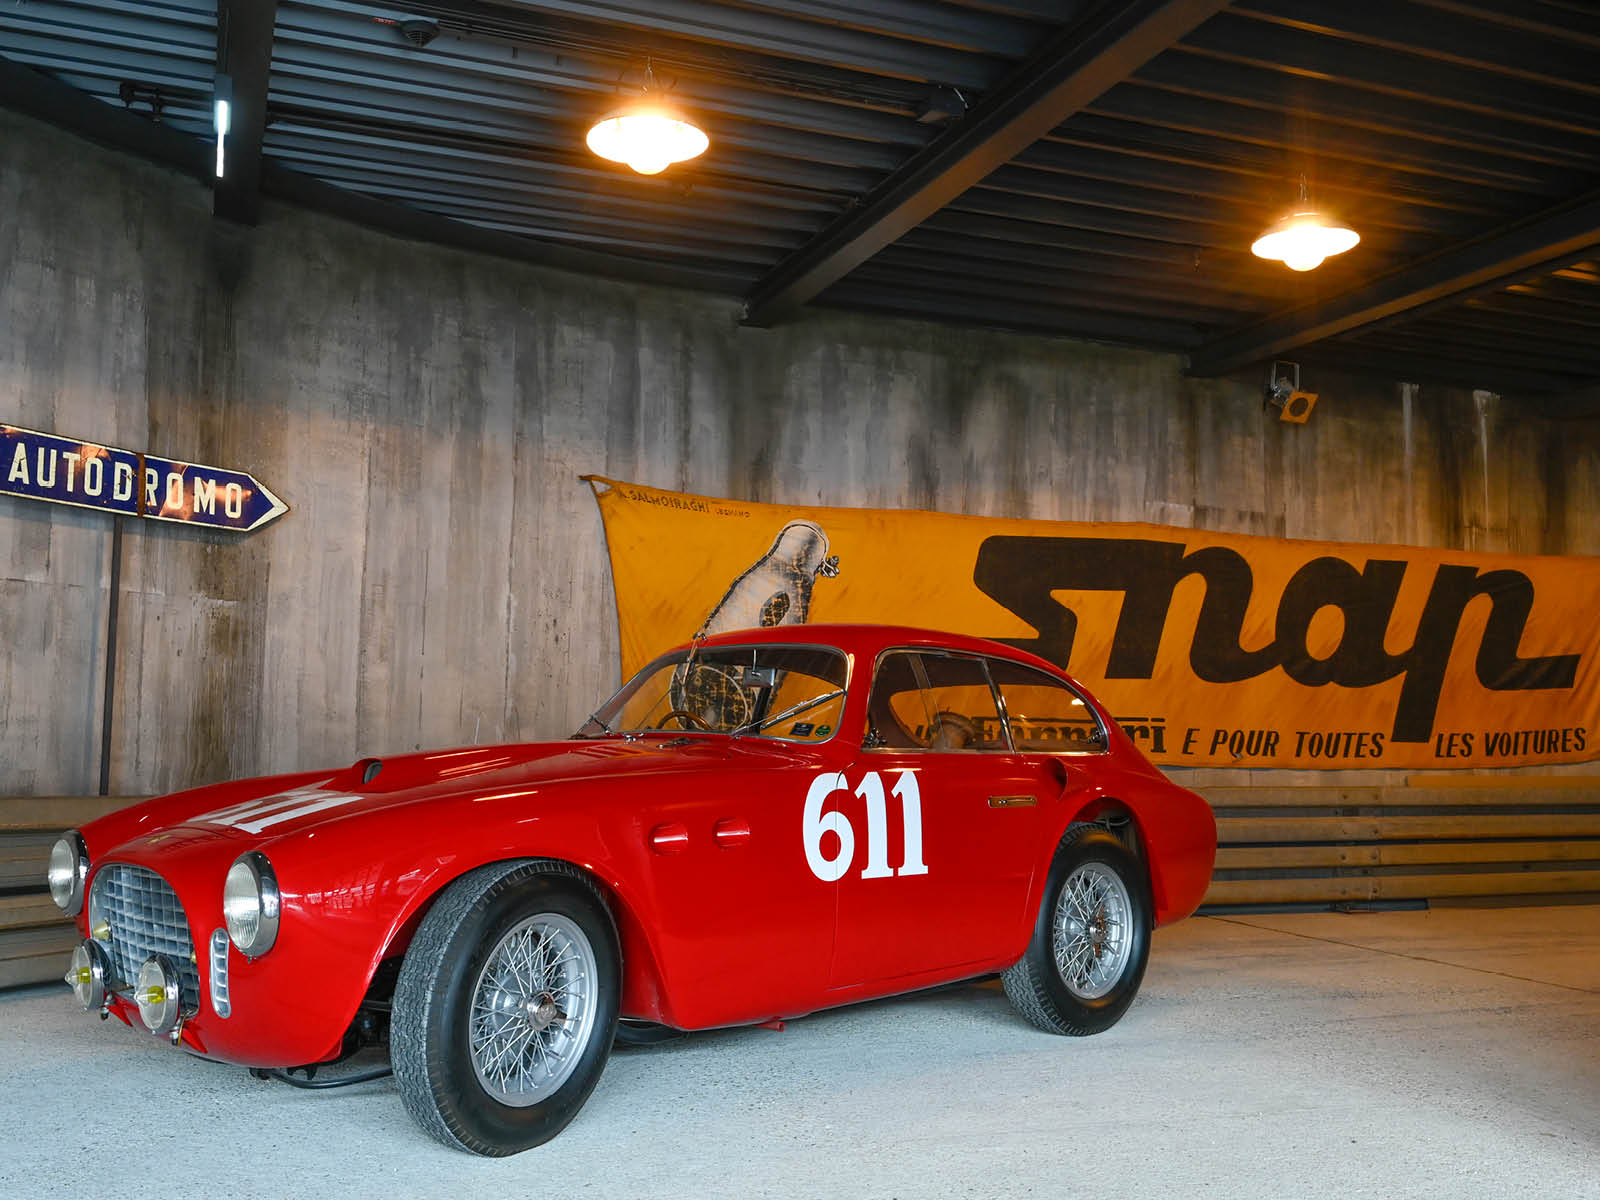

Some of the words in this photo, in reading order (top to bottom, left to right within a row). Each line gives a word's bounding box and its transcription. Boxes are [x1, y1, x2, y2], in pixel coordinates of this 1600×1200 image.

[8, 442, 242, 519] AUTODROMO
[971, 716, 1167, 753] Frrri
[1182, 728, 1200, 755] E
[1209, 729, 1280, 758] POUR
[1295, 731, 1385, 759] TOUTES
[1435, 732, 1475, 758] LES
[1484, 727, 1587, 758] VOITURES
[802, 771, 929, 882] 611
